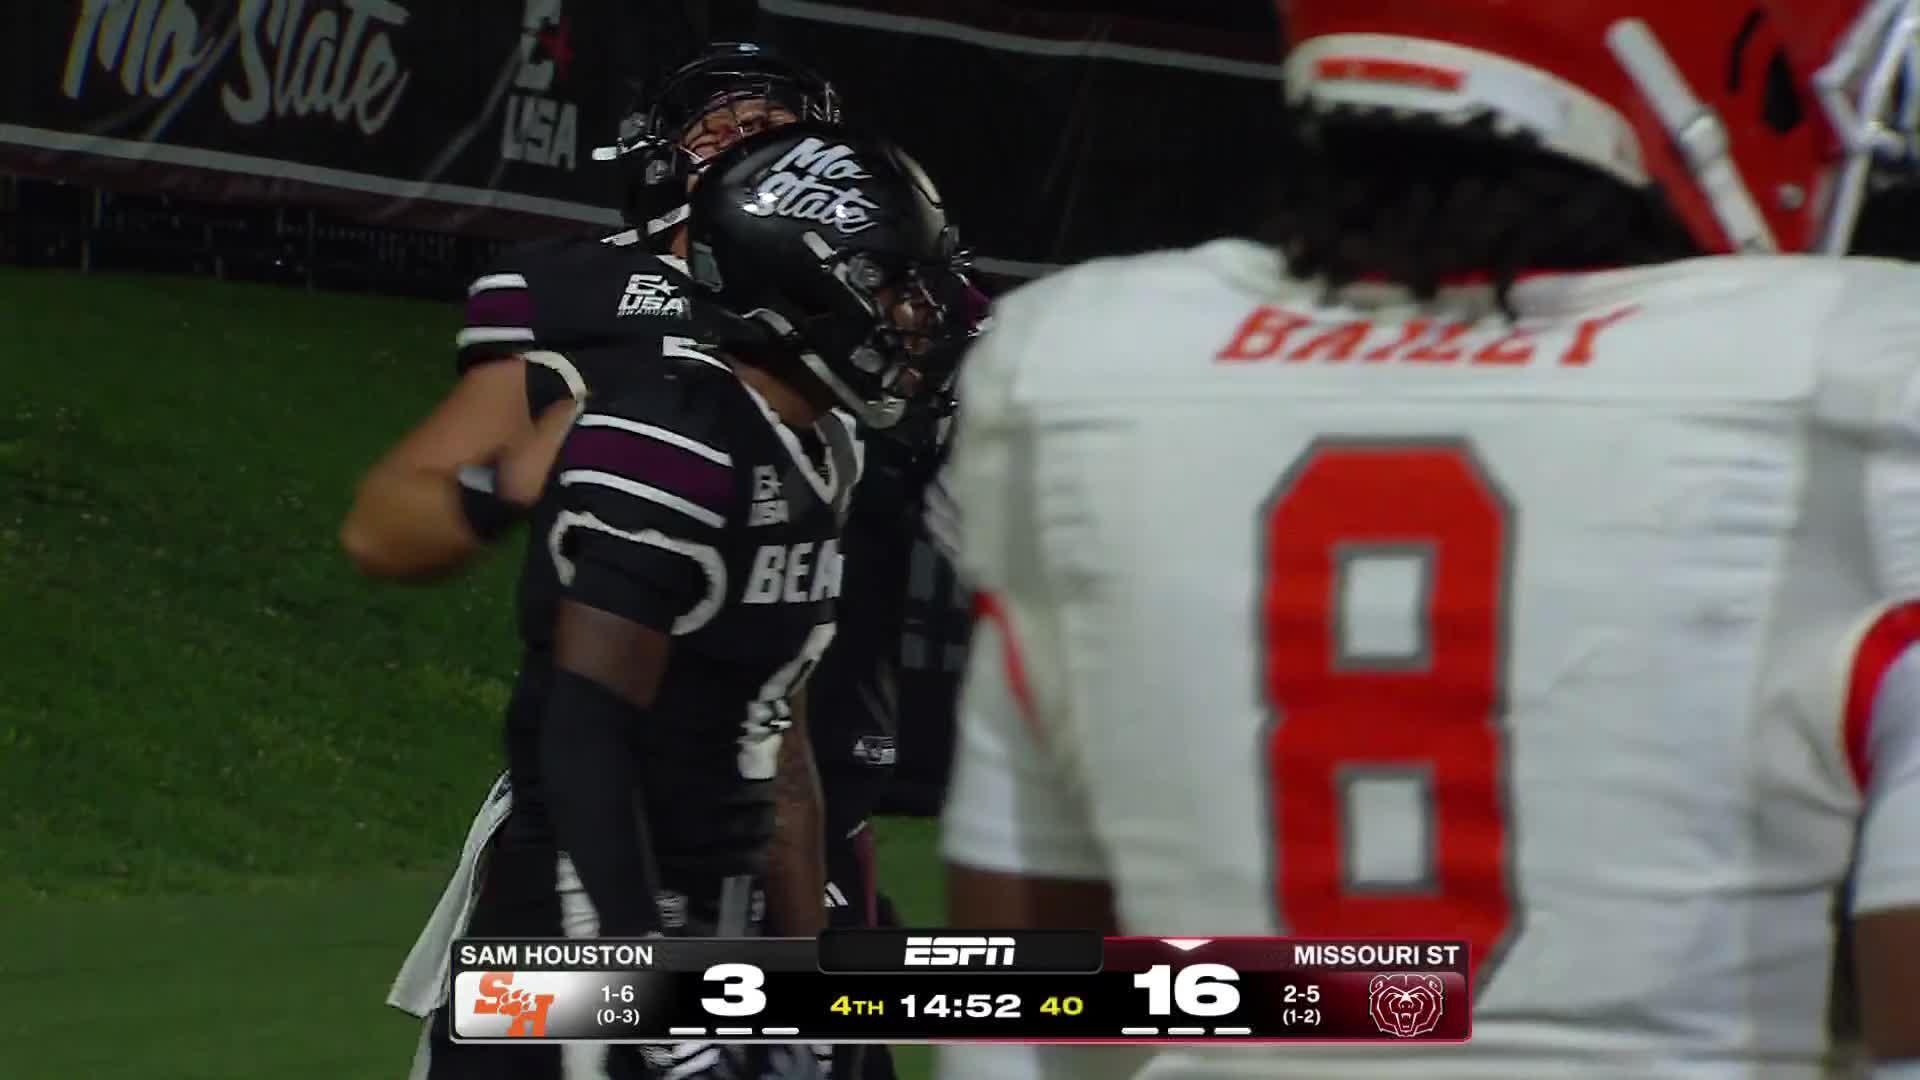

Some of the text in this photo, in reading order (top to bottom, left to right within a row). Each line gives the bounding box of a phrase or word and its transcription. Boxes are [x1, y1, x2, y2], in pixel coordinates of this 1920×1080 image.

[223, 0, 407, 134] State
[504, 96, 577, 168] USA
[771, 136, 872, 179] Mo
[742, 172, 880, 234] State
[618, 293, 684, 316] USA
[1213, 302, 1642, 366] BAILEY
[1257, 435, 1522, 1002] 8
